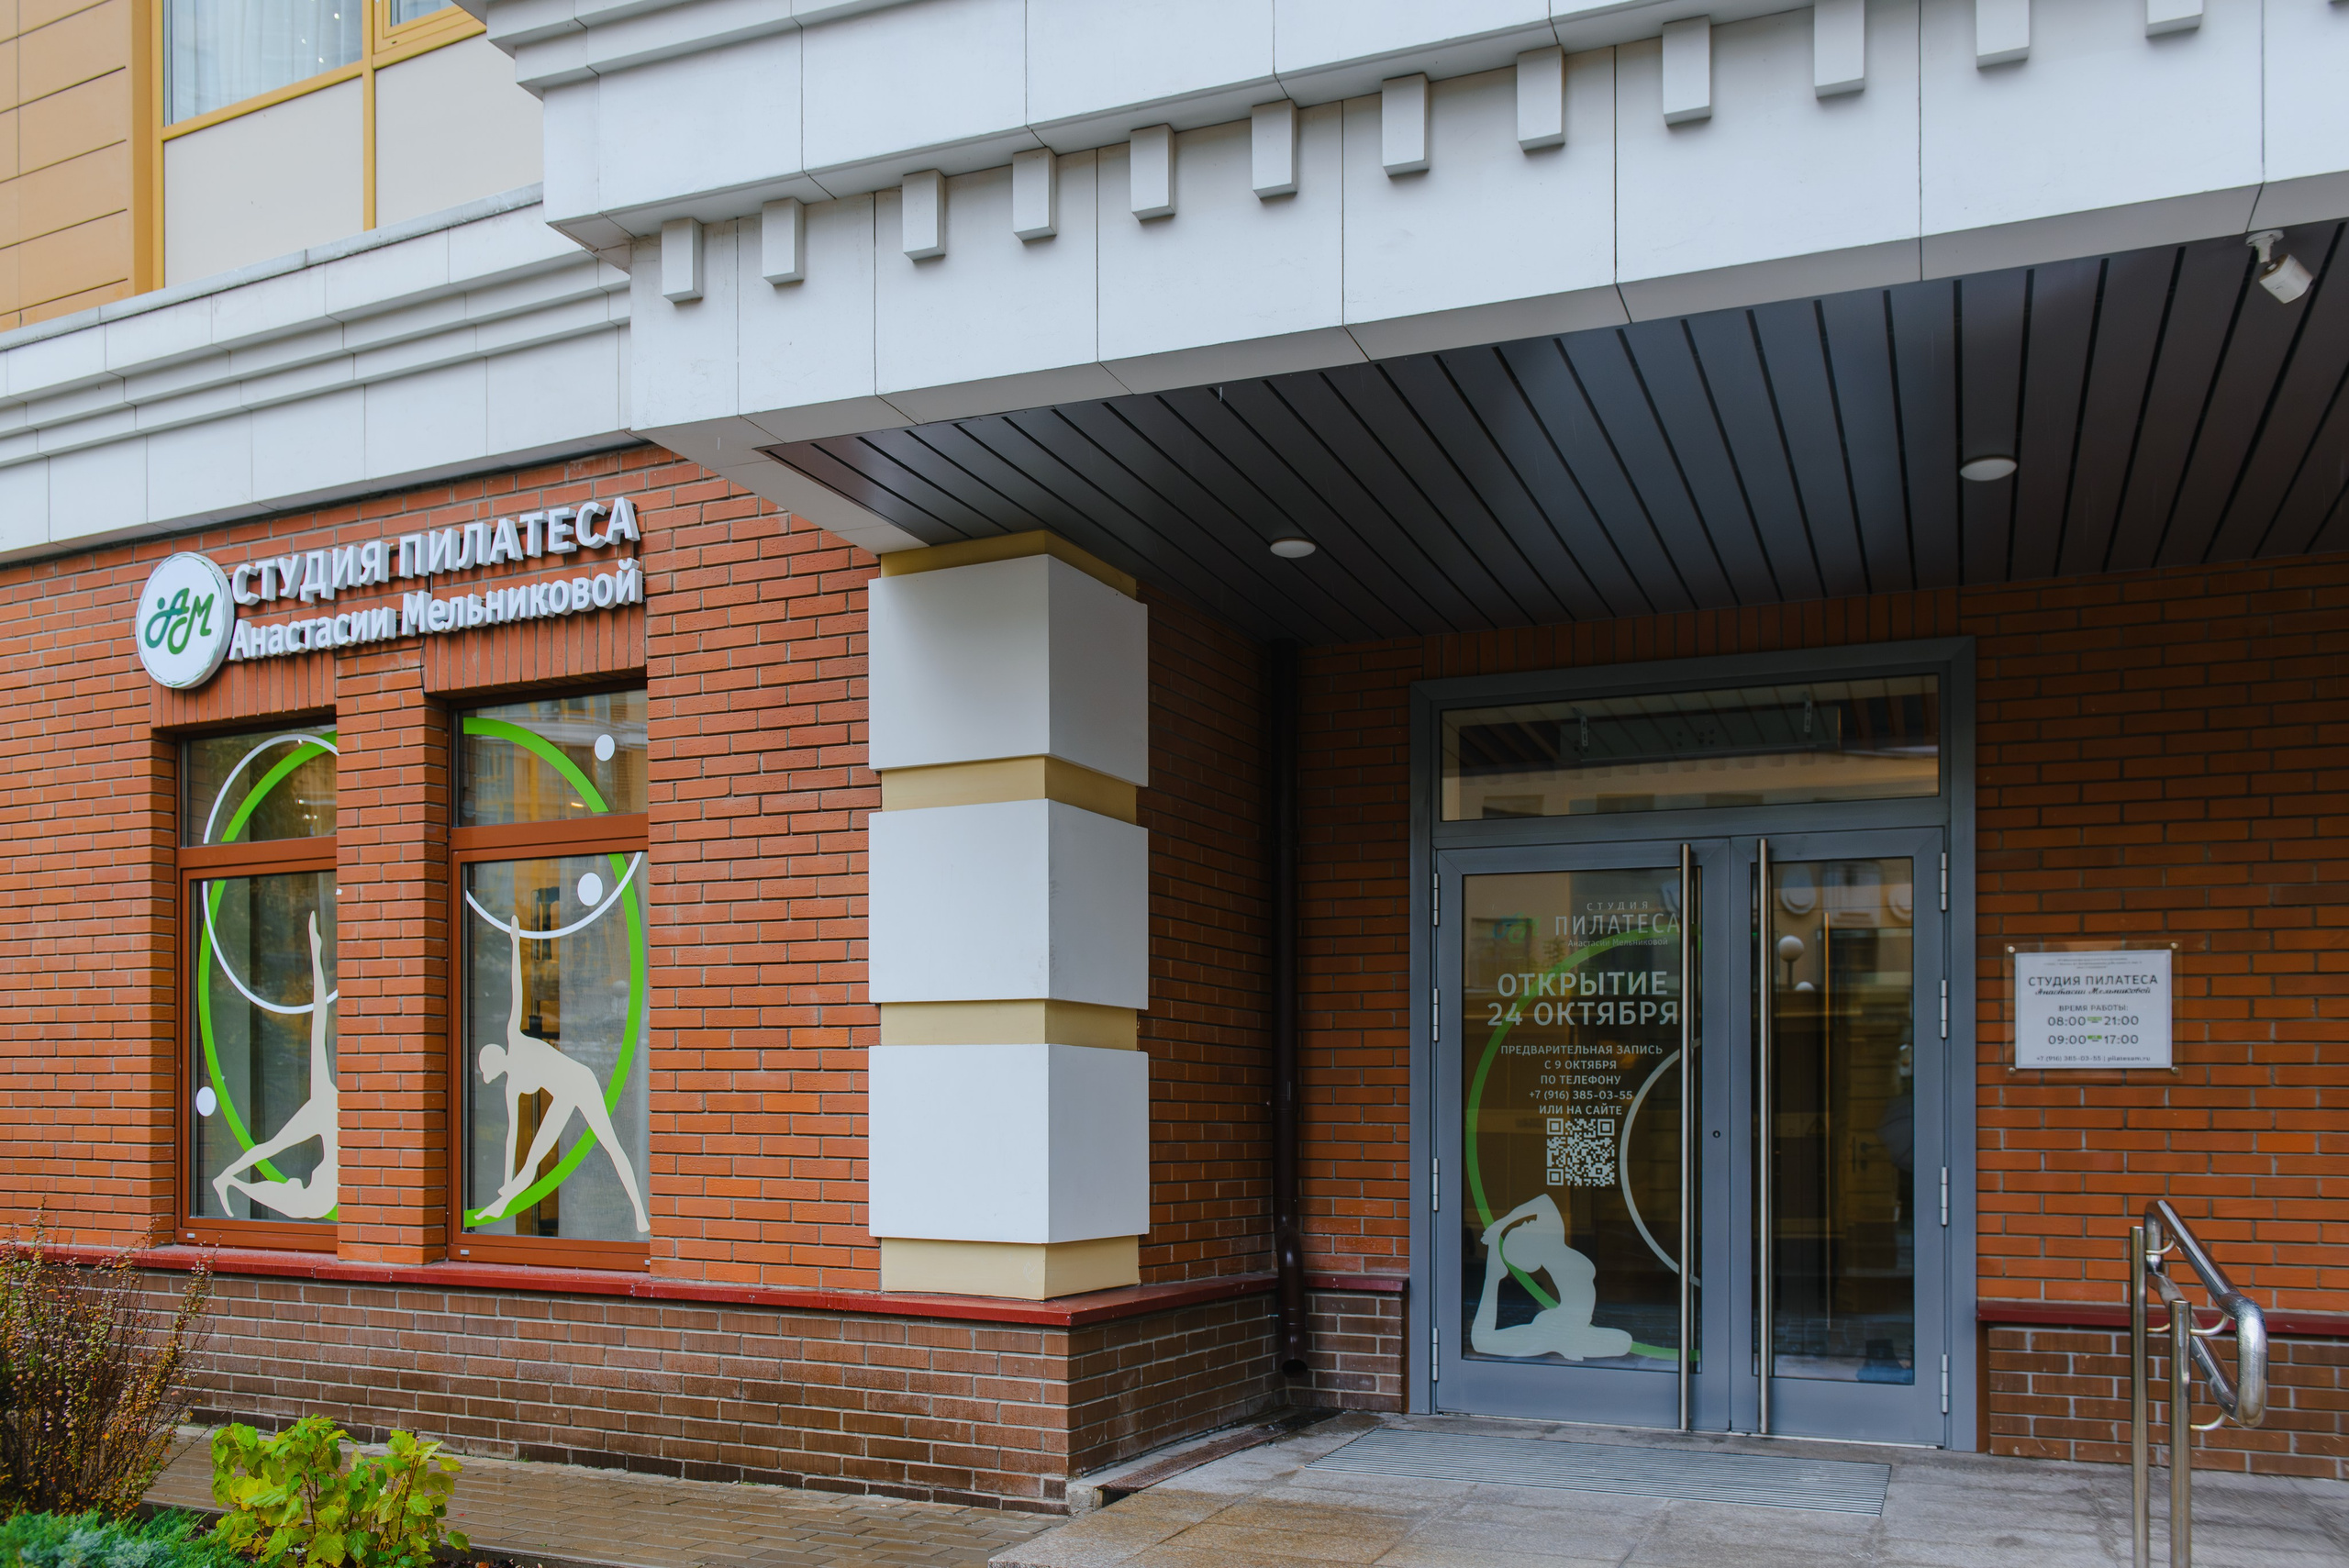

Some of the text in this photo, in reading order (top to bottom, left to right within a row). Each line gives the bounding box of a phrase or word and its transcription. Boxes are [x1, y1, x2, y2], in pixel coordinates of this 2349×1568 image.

[232, 497, 640, 606] СТУДИЯ ПИЛАТЕСА
[228, 558, 642, 661] Анастасии Мельниковой
[1586, 901, 1648, 911] СТУДИЯ
[1555, 913, 1680, 935] ПИЛАТЕСА
[1568, 937, 1668, 947] Анастасии Мельниковой
[1497, 972, 1667, 996] ОТКРЫТИЕ
[2029, 974, 2158, 987] СТУДИЯ ПИЛАТЕСА
[1487, 1001, 1678, 1026] 24 ОКТЯБРЯ
[2048, 1017, 2086, 1026] 08:00
[2104, 1016, 2139, 1026] 21:00
[2048, 1035, 2086, 1044] 09:00
[2104, 1035, 2139, 1044] 17:00
[1501, 1045, 1663, 1055] ПРЕДВАРИТЕЛЬНАЯ ЗАПИСЬ
[1544, 1060, 1617, 1070] С 9 ОКТЯБРЯ
[1541, 1074, 1620, 1085] ПО ТЕЛЕФОНУ
[1530, 1090, 1632, 1101] +7 (916) 385-03-55
[1539, 1103, 1622, 1115] ИЛИ НА САЙТЕ
